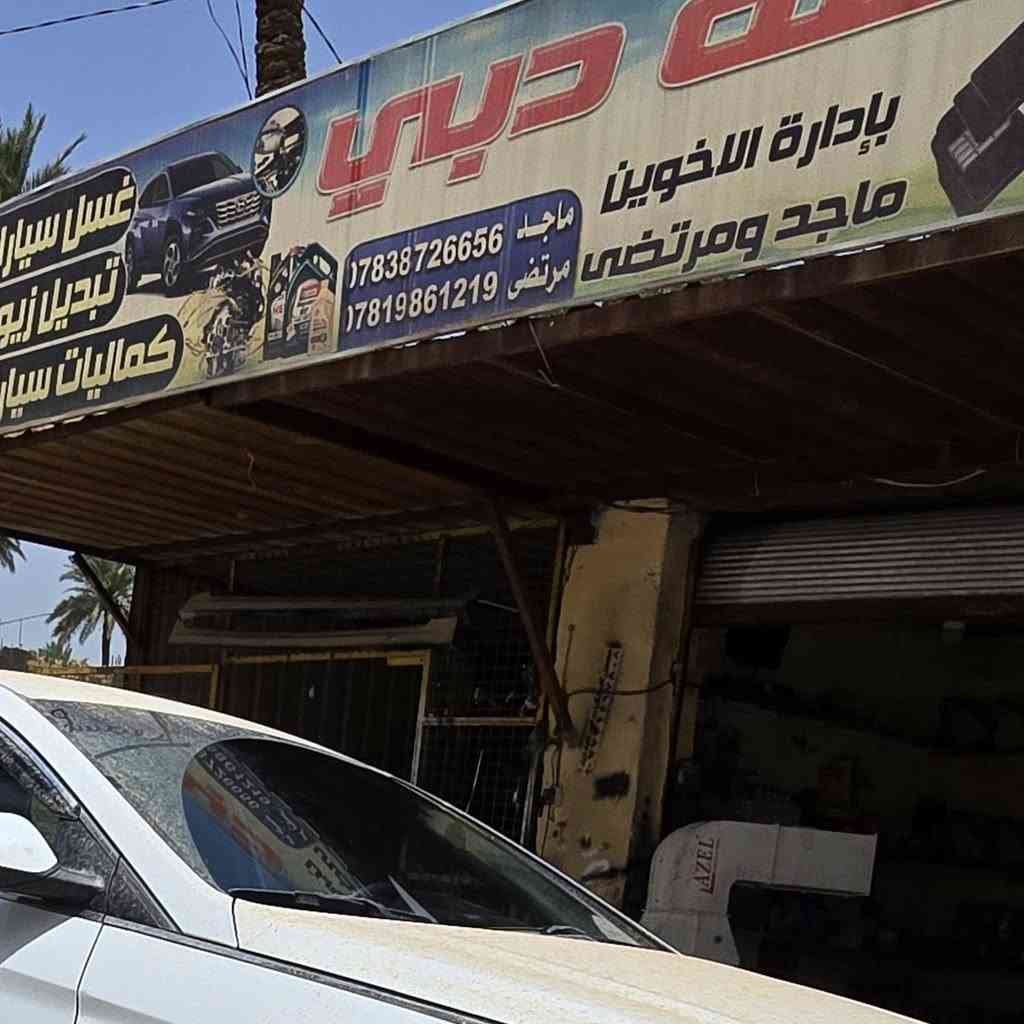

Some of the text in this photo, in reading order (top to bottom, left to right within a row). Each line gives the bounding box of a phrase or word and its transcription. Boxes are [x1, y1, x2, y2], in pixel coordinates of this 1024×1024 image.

[317, 22, 625, 221] دبي
[599, 125, 764, 215] الاخوين
[516, 200, 574, 243] ماجد
[580, 178, 909, 282] ماجد ومرتضى
[37, 255, 120, 335] تبديل
[56, 323, 177, 400] كماليات
